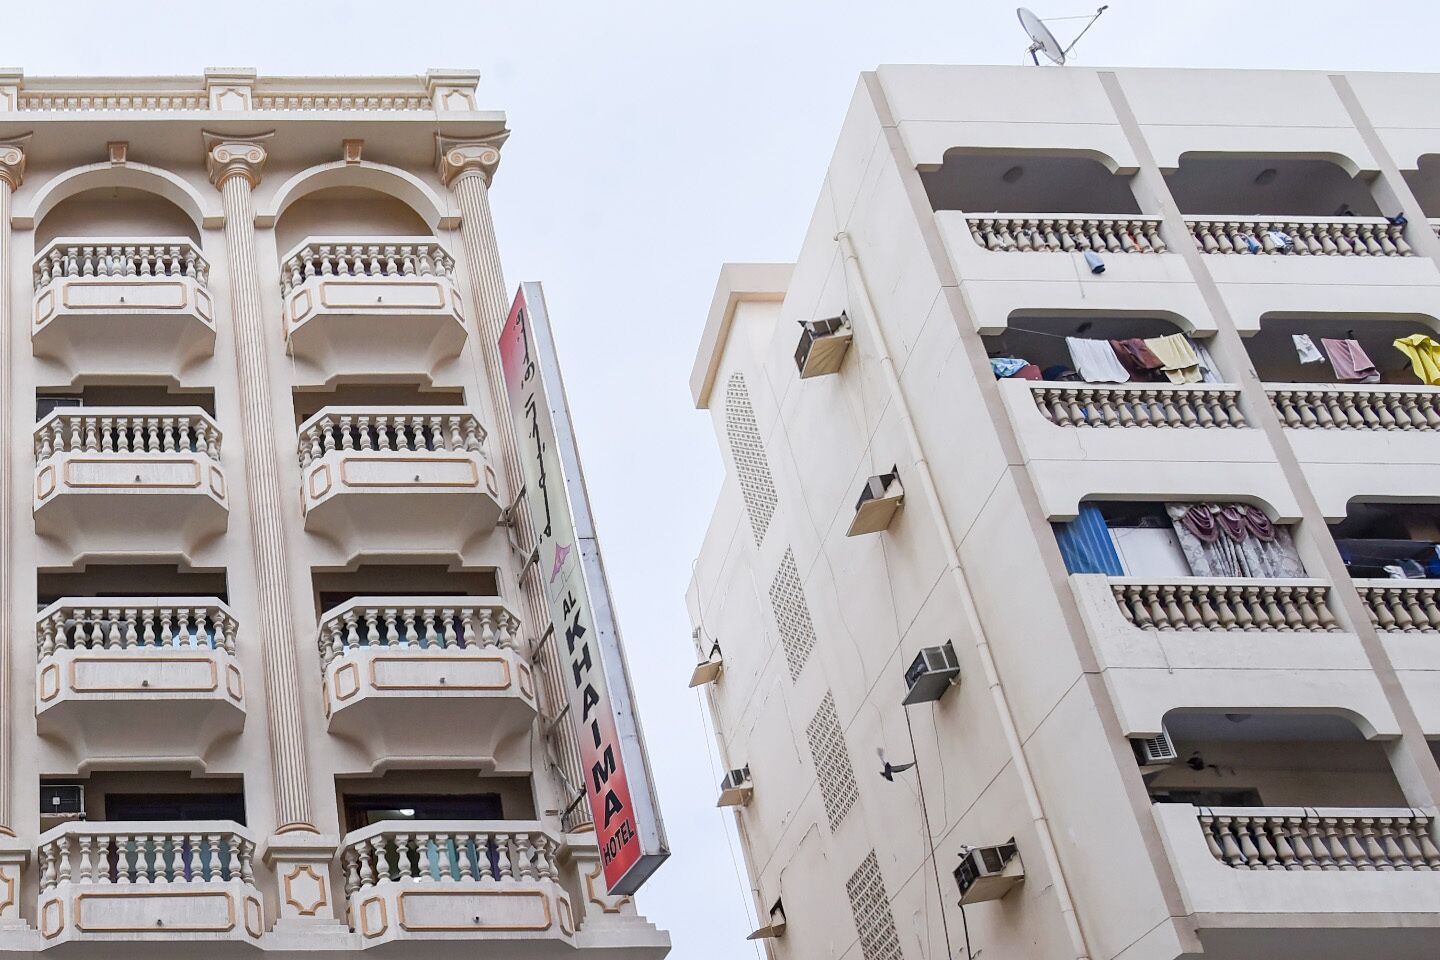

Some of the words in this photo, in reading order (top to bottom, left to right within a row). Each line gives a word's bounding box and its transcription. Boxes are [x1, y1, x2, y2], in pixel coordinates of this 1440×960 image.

[562, 590, 577, 620] AL
[565, 608, 624, 830] KHAIMA
[602, 818, 635, 867] HOTEL
